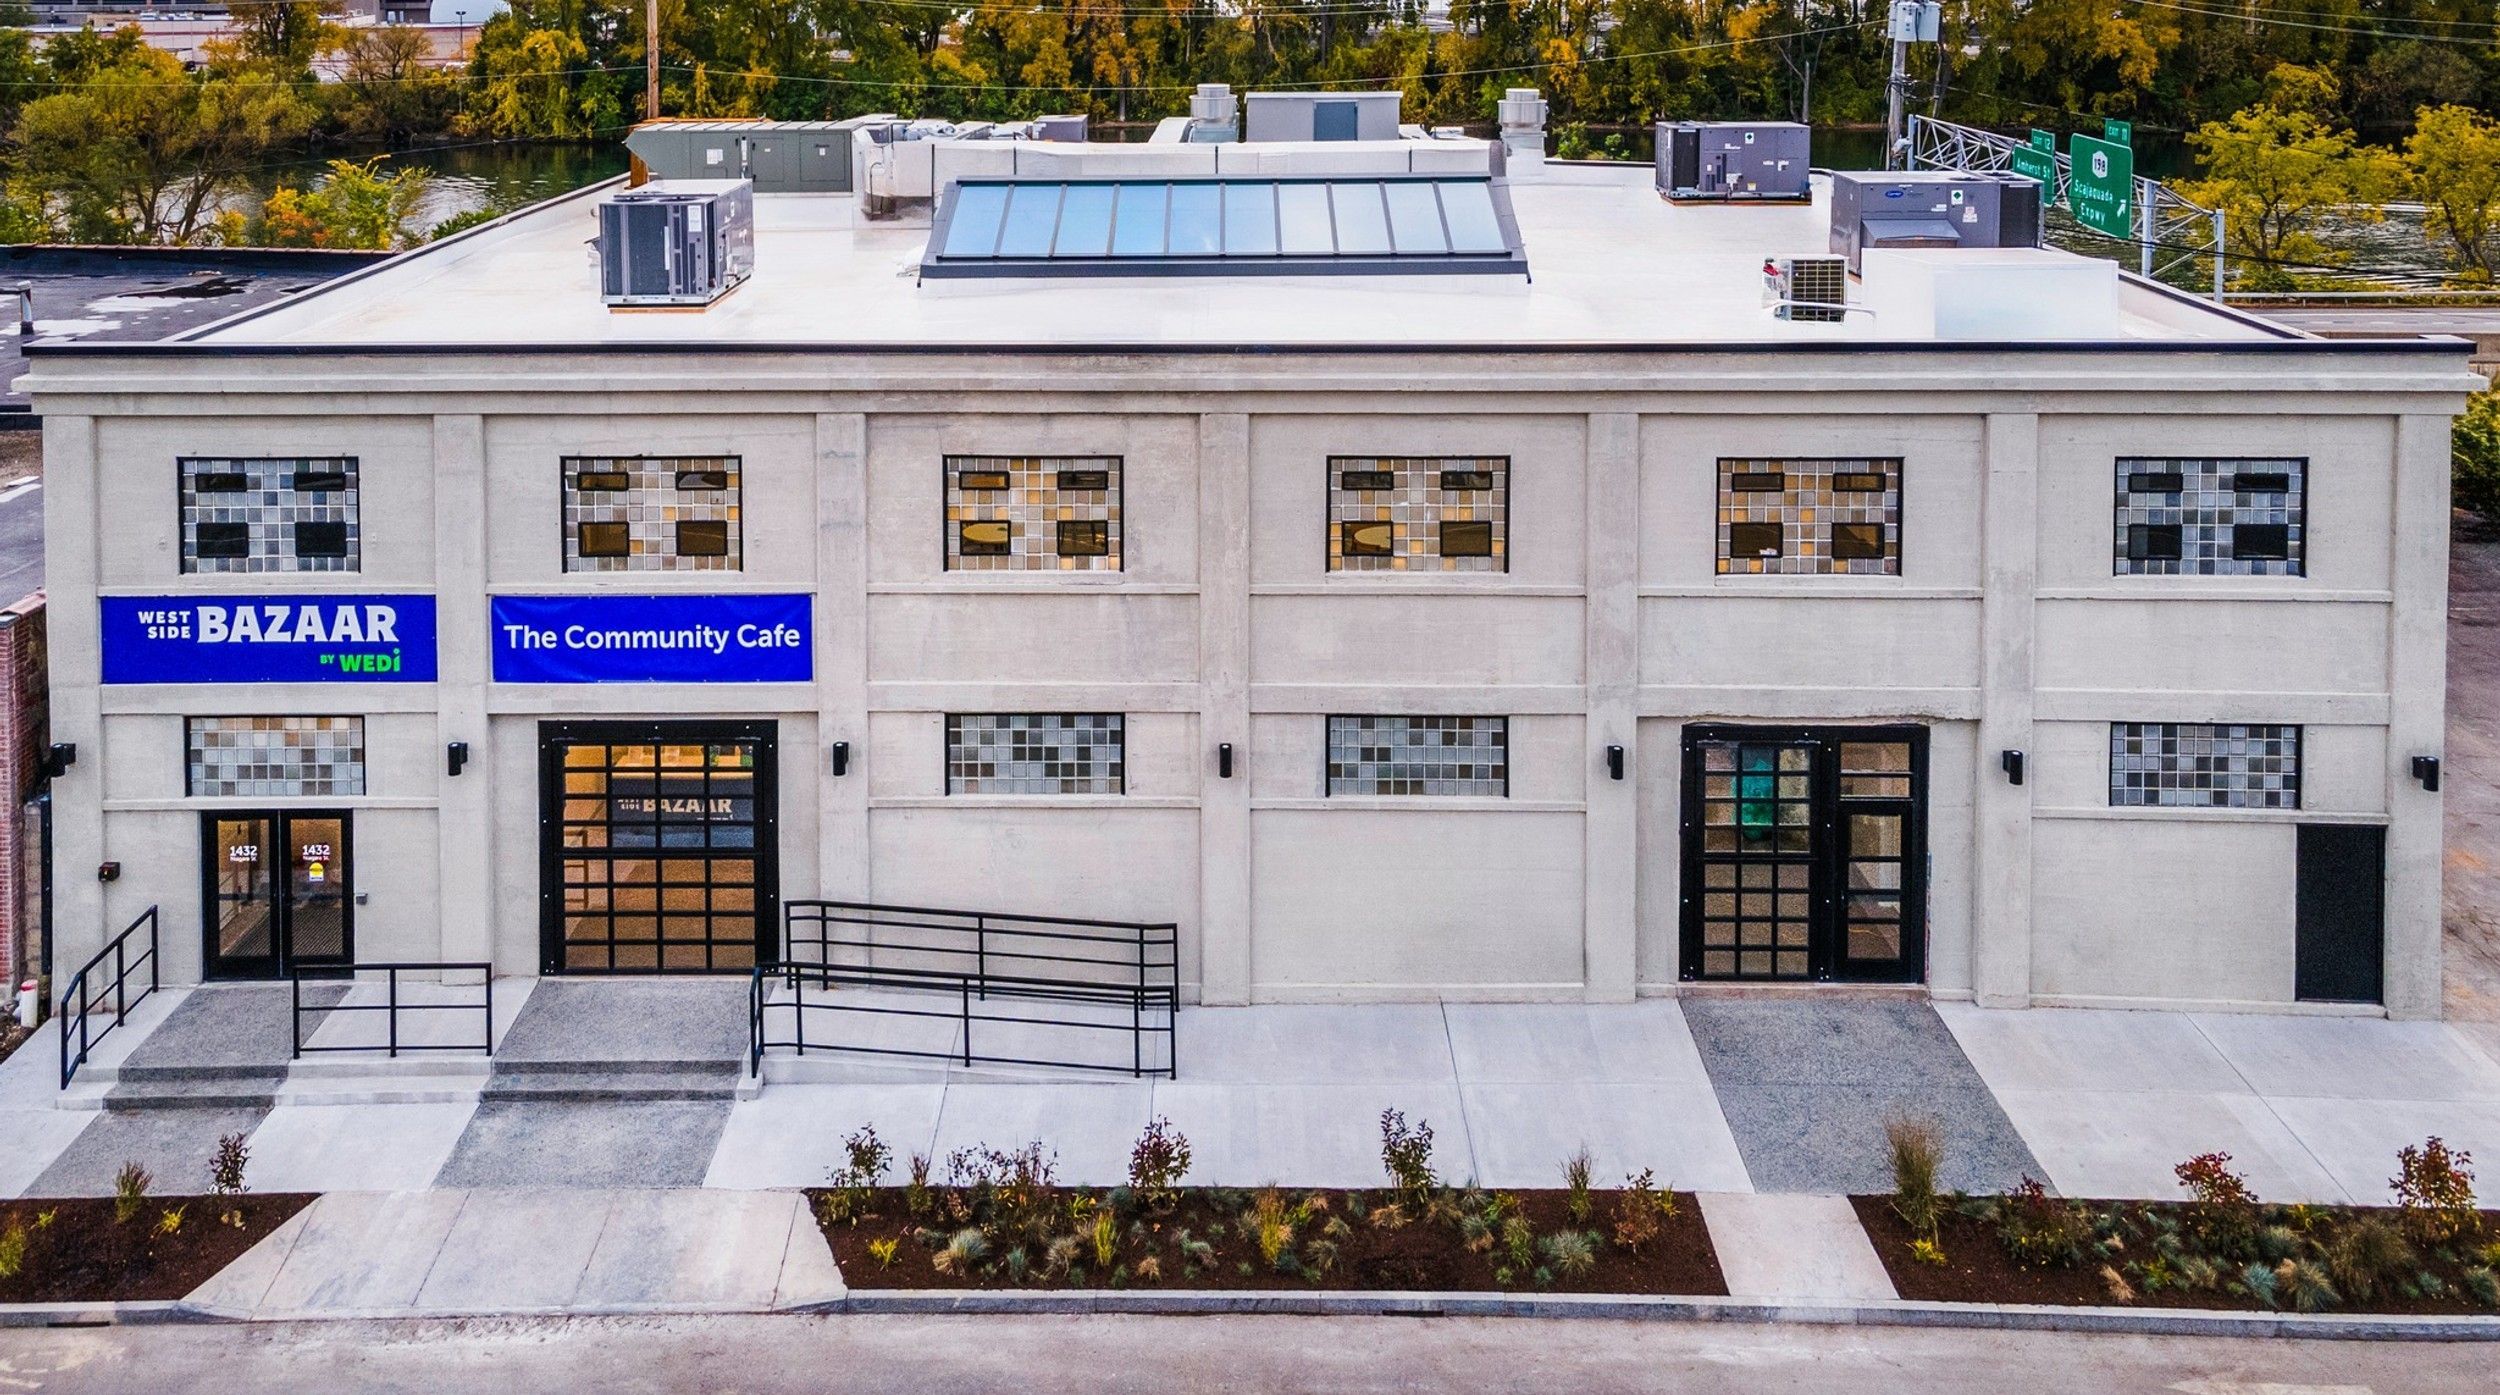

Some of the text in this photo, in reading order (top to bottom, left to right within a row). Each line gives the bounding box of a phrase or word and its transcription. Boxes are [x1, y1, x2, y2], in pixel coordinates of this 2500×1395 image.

[2094, 158, 2106, 172] 198
[2080, 202, 2106, 226] Expwy
[137, 610, 191, 625] WEST
[196, 605, 400, 643] BAZAAR
[147, 626, 191, 639] SIDE
[503, 623, 801, 655] The Community Cafe
[319, 654, 335, 665] BY
[229, 845, 258, 856] 1432
[302, 844, 330, 855] 1432
